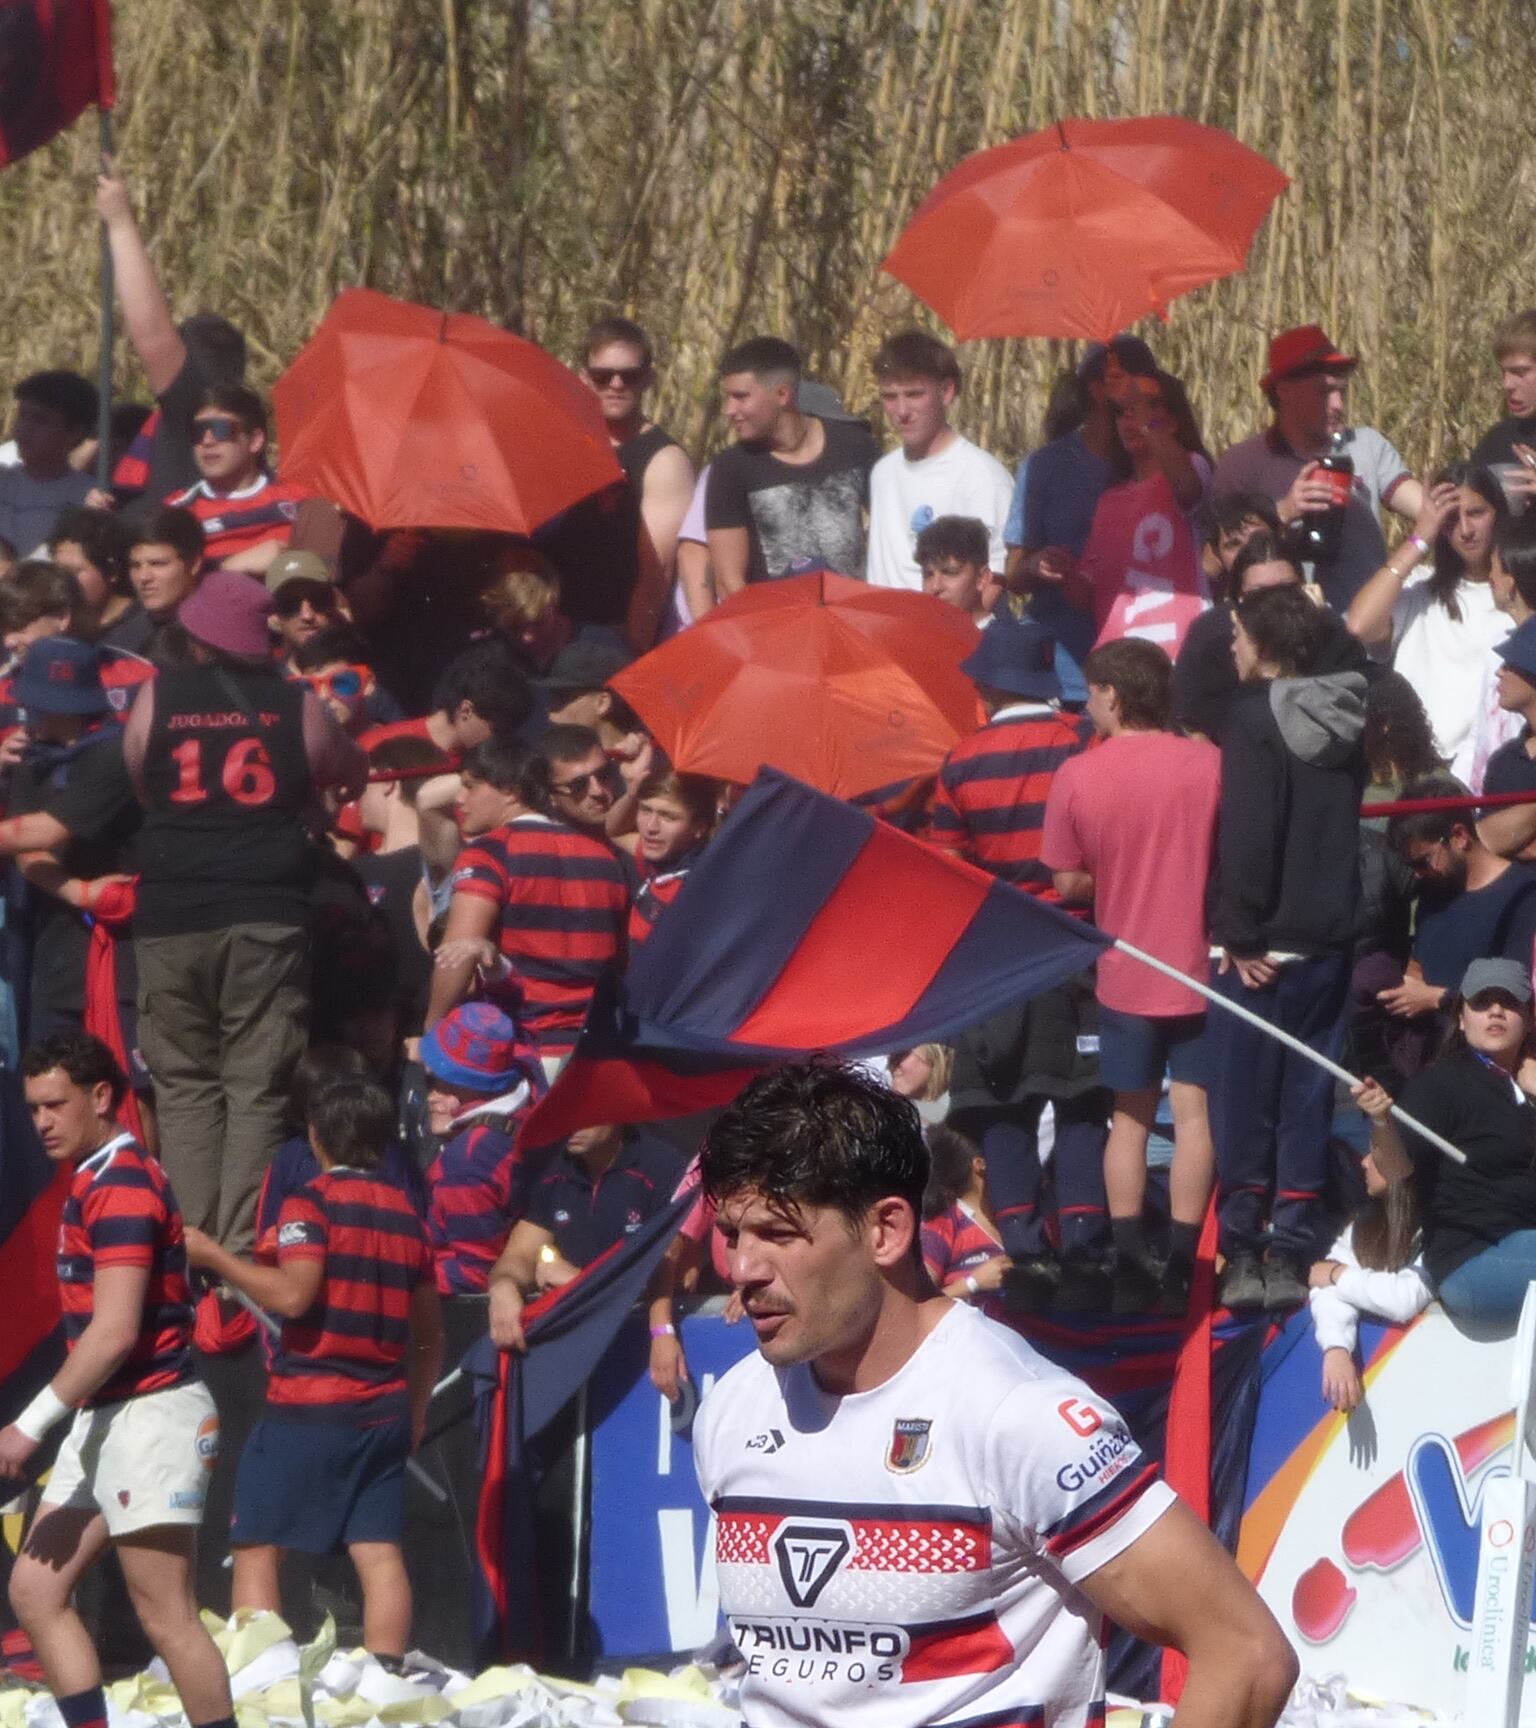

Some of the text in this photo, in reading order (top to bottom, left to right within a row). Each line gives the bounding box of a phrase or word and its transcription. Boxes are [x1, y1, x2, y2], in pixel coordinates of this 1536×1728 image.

[168, 737, 276, 805] 16
[1056, 1398, 1104, 1438] G
[734, 1623, 903, 1659] TRIUNFO
[747, 1654, 896, 1683] EGUROS
